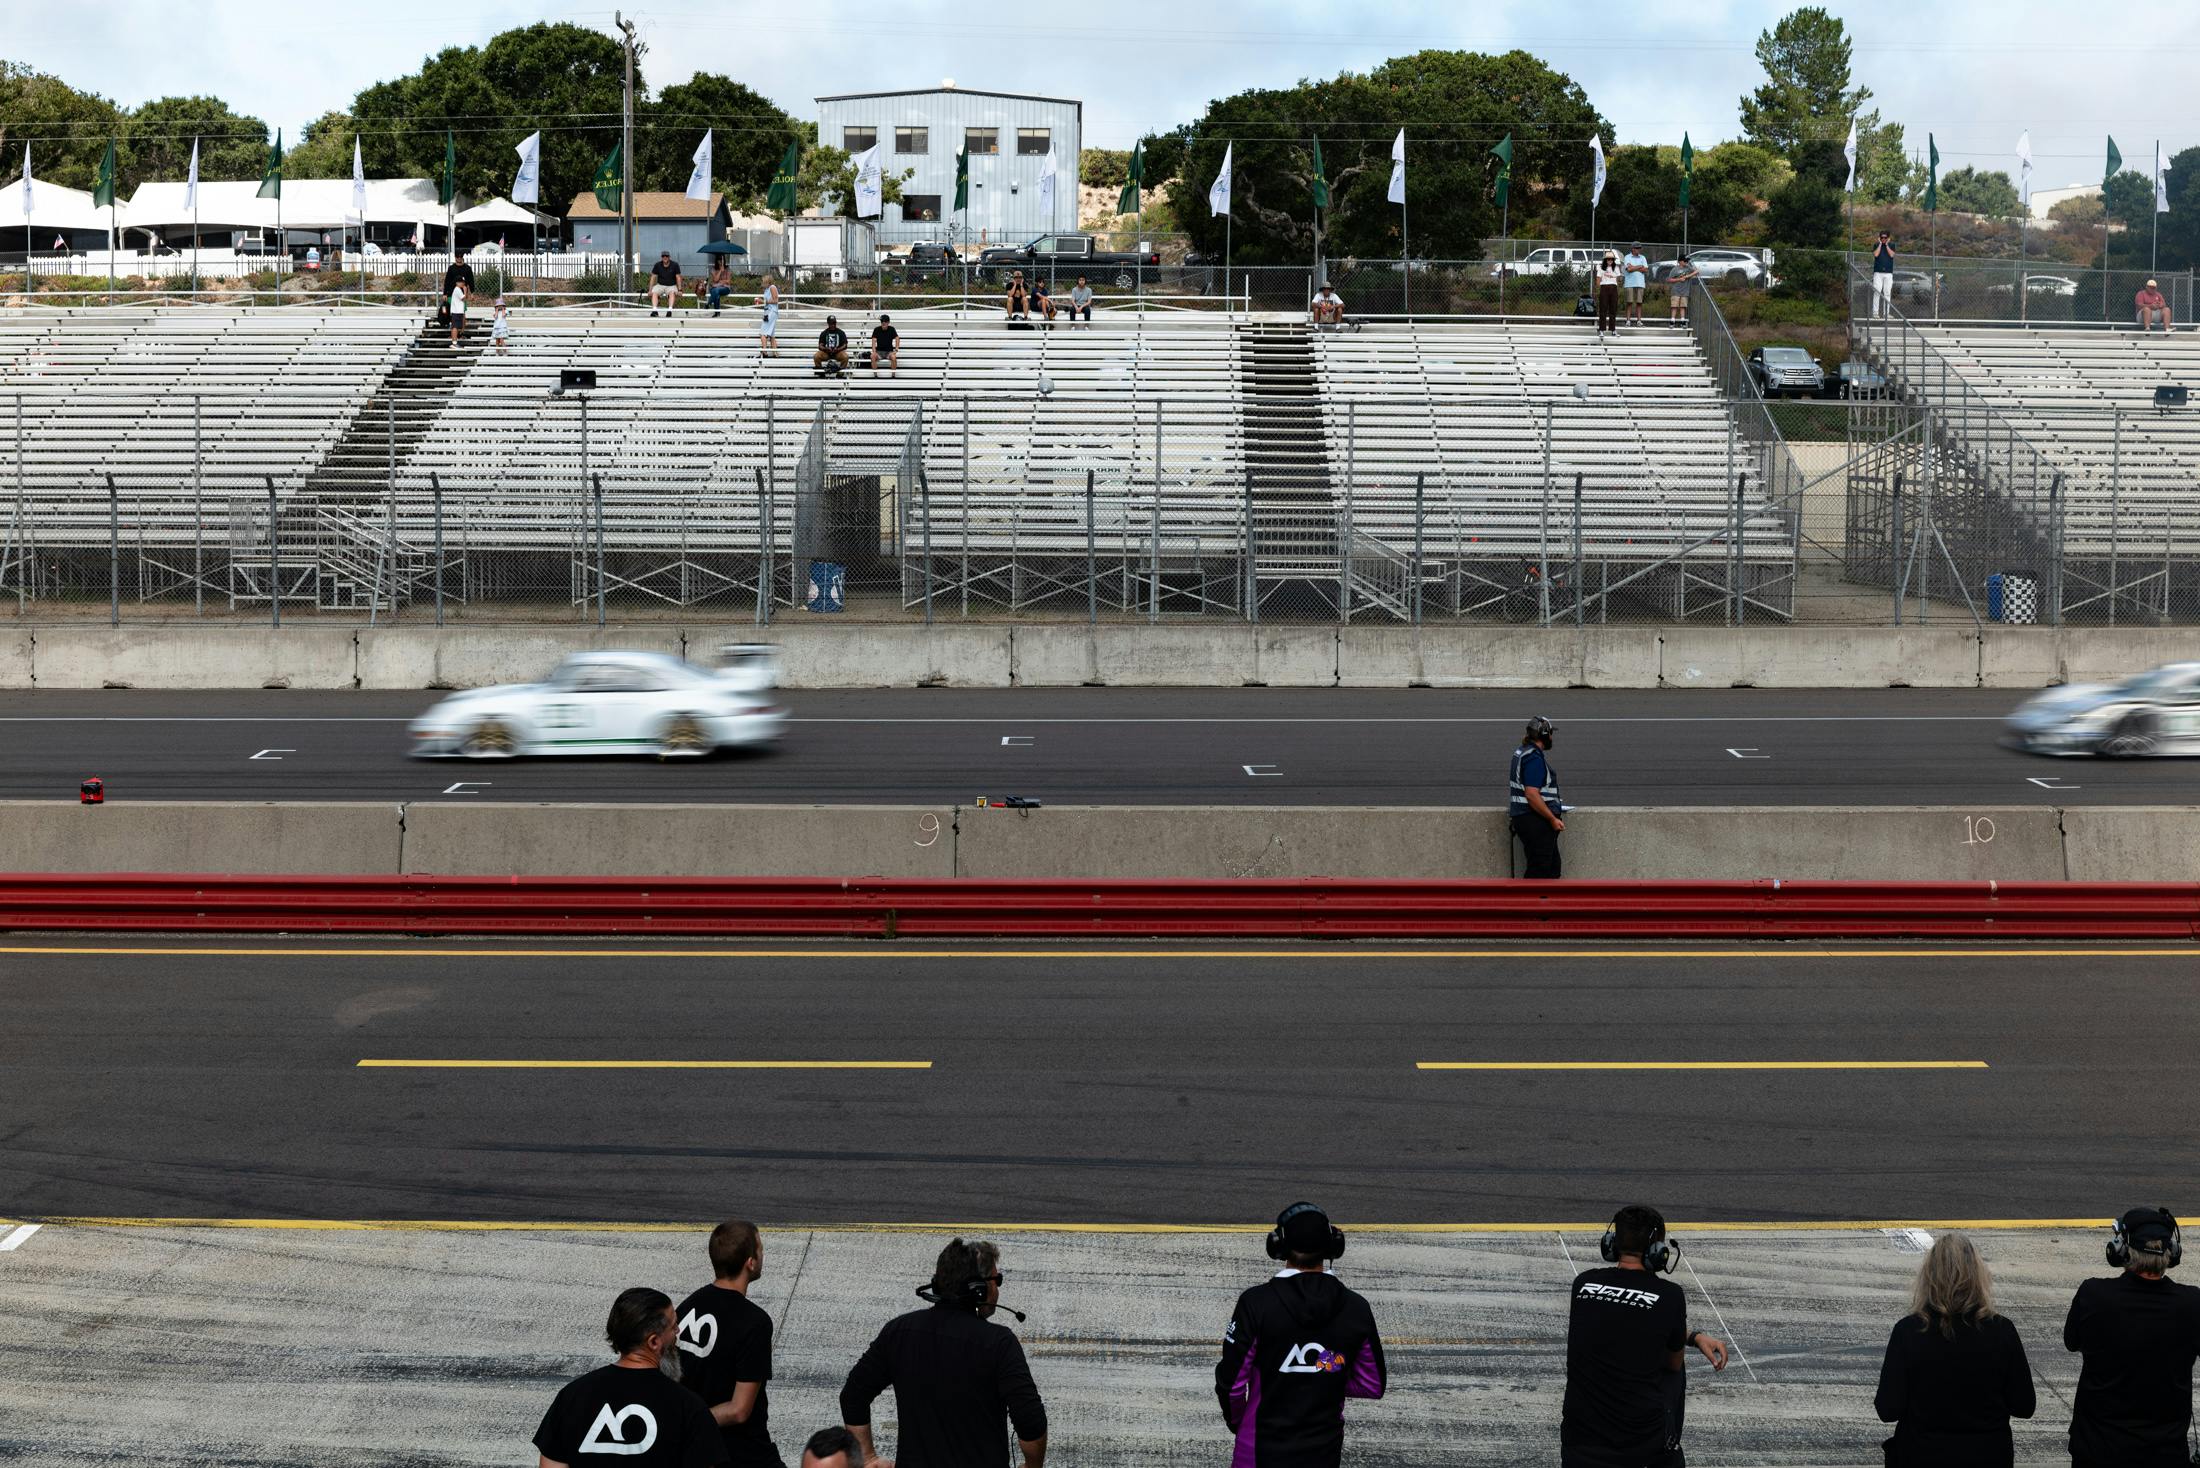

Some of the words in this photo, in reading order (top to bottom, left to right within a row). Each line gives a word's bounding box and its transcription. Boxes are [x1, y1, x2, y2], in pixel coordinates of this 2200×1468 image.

[914, 813, 939, 847] 9
[1960, 815, 1996, 846] 10
[578, 1402, 658, 1455] AO
